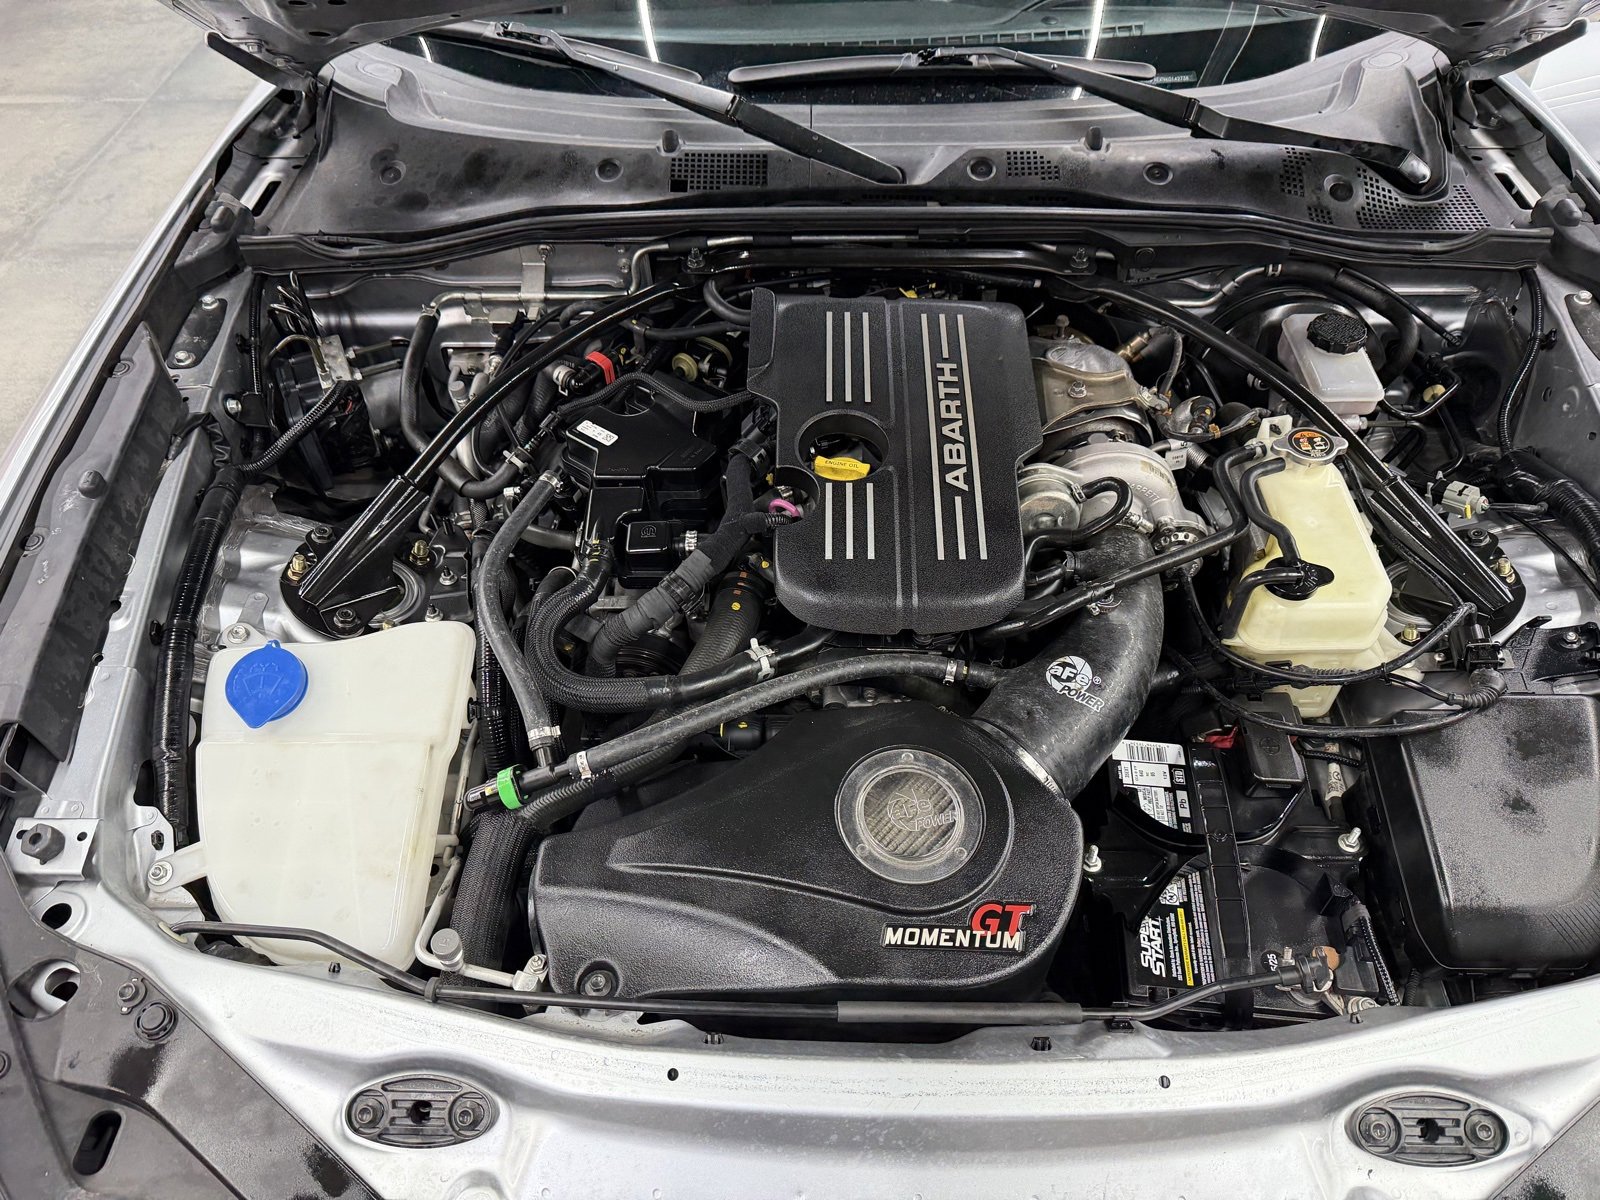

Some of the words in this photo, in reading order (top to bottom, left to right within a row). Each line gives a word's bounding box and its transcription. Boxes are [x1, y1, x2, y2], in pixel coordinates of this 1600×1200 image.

[936, 363, 969, 491] ABARTH
[1057, 685, 1105, 713] POWER
[1179, 798, 1187, 810] Pb
[915, 810, 959, 832] POWER
[971, 903, 1032, 937] GT
[885, 927, 1021, 950] MOMENTUM
[1149, 918, 1165, 977] START
